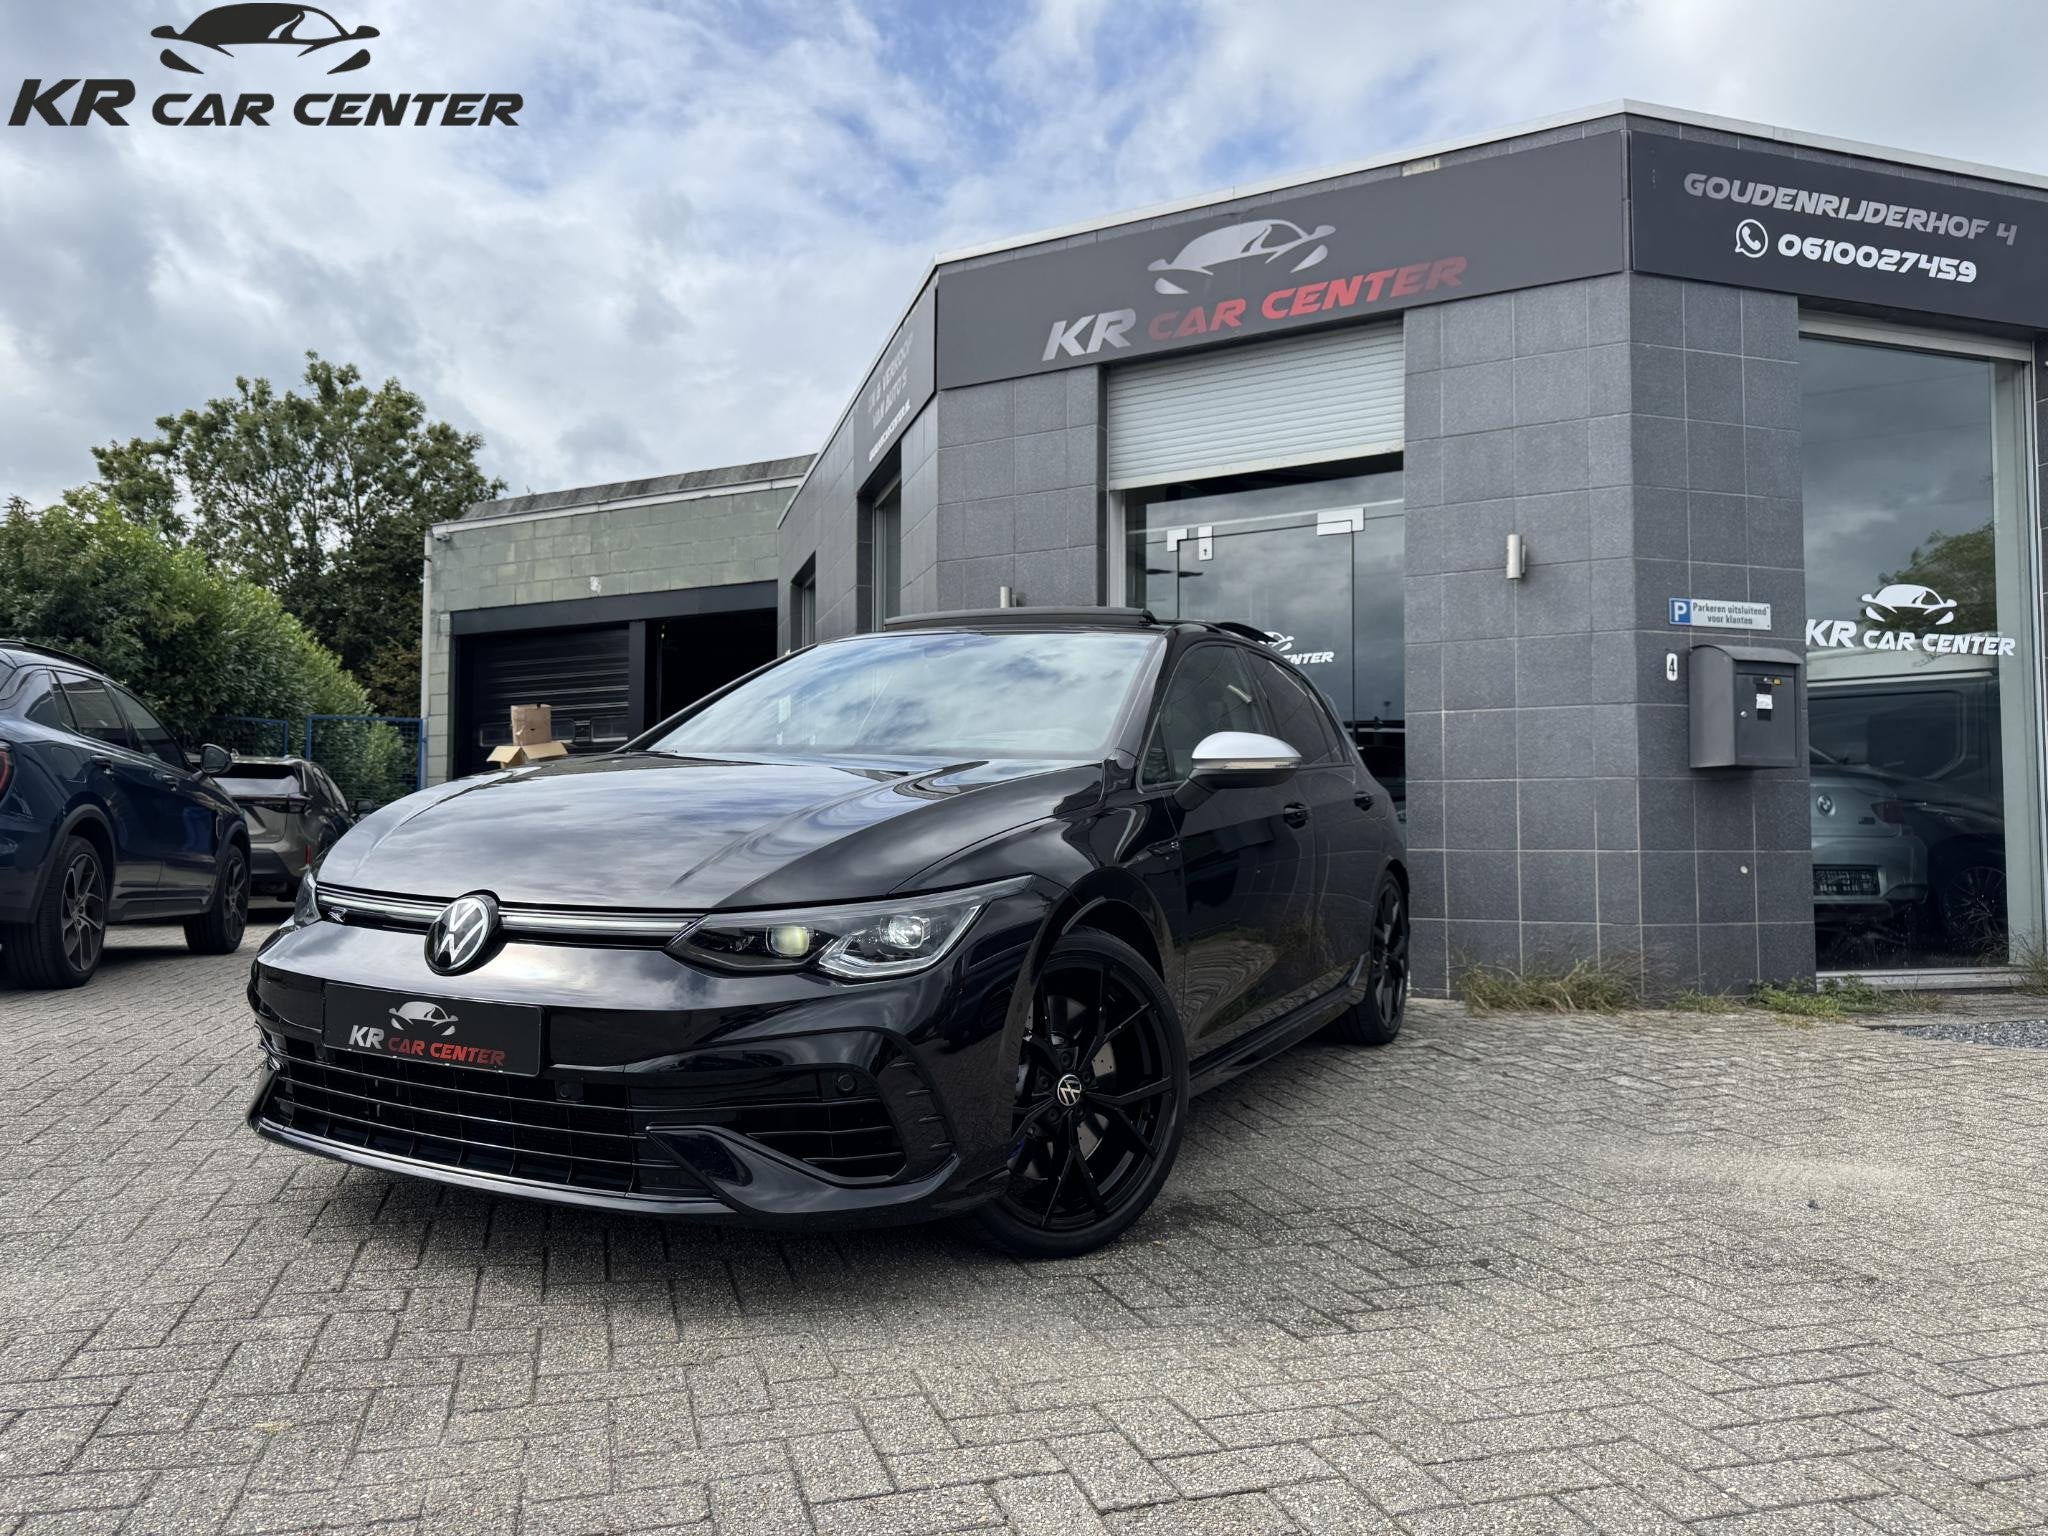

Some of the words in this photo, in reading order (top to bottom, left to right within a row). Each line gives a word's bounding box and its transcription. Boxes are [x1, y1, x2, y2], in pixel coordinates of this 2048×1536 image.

[1684, 172, 1990, 240] GOUDENRIJDERHOF
[1996, 224, 2018, 246] 4
[1777, 233, 1977, 284] 0610027459
[1042, 308, 1136, 361] KR
[1148, 298, 1246, 341] CAR
[1262, 256, 1467, 317] CENTER
[1674, 602, 1687, 621] P
[1693, 603, 1726, 613] Parkeren
[1728, 605, 1767, 616] uitsluitend
[1707, 615, 1723, 623] voor
[1726, 615, 1753, 625] klanten
[1805, 619, 1857, 647] KR
[1863, 630, 1916, 650] CAR
[1922, 633, 2016, 656] CENTER
[1669, 658, 1676, 676] 4
[349, 1025, 384, 1050] KR
[388, 1037, 425, 1056] CAR
[430, 1043, 505, 1066] CENTER
